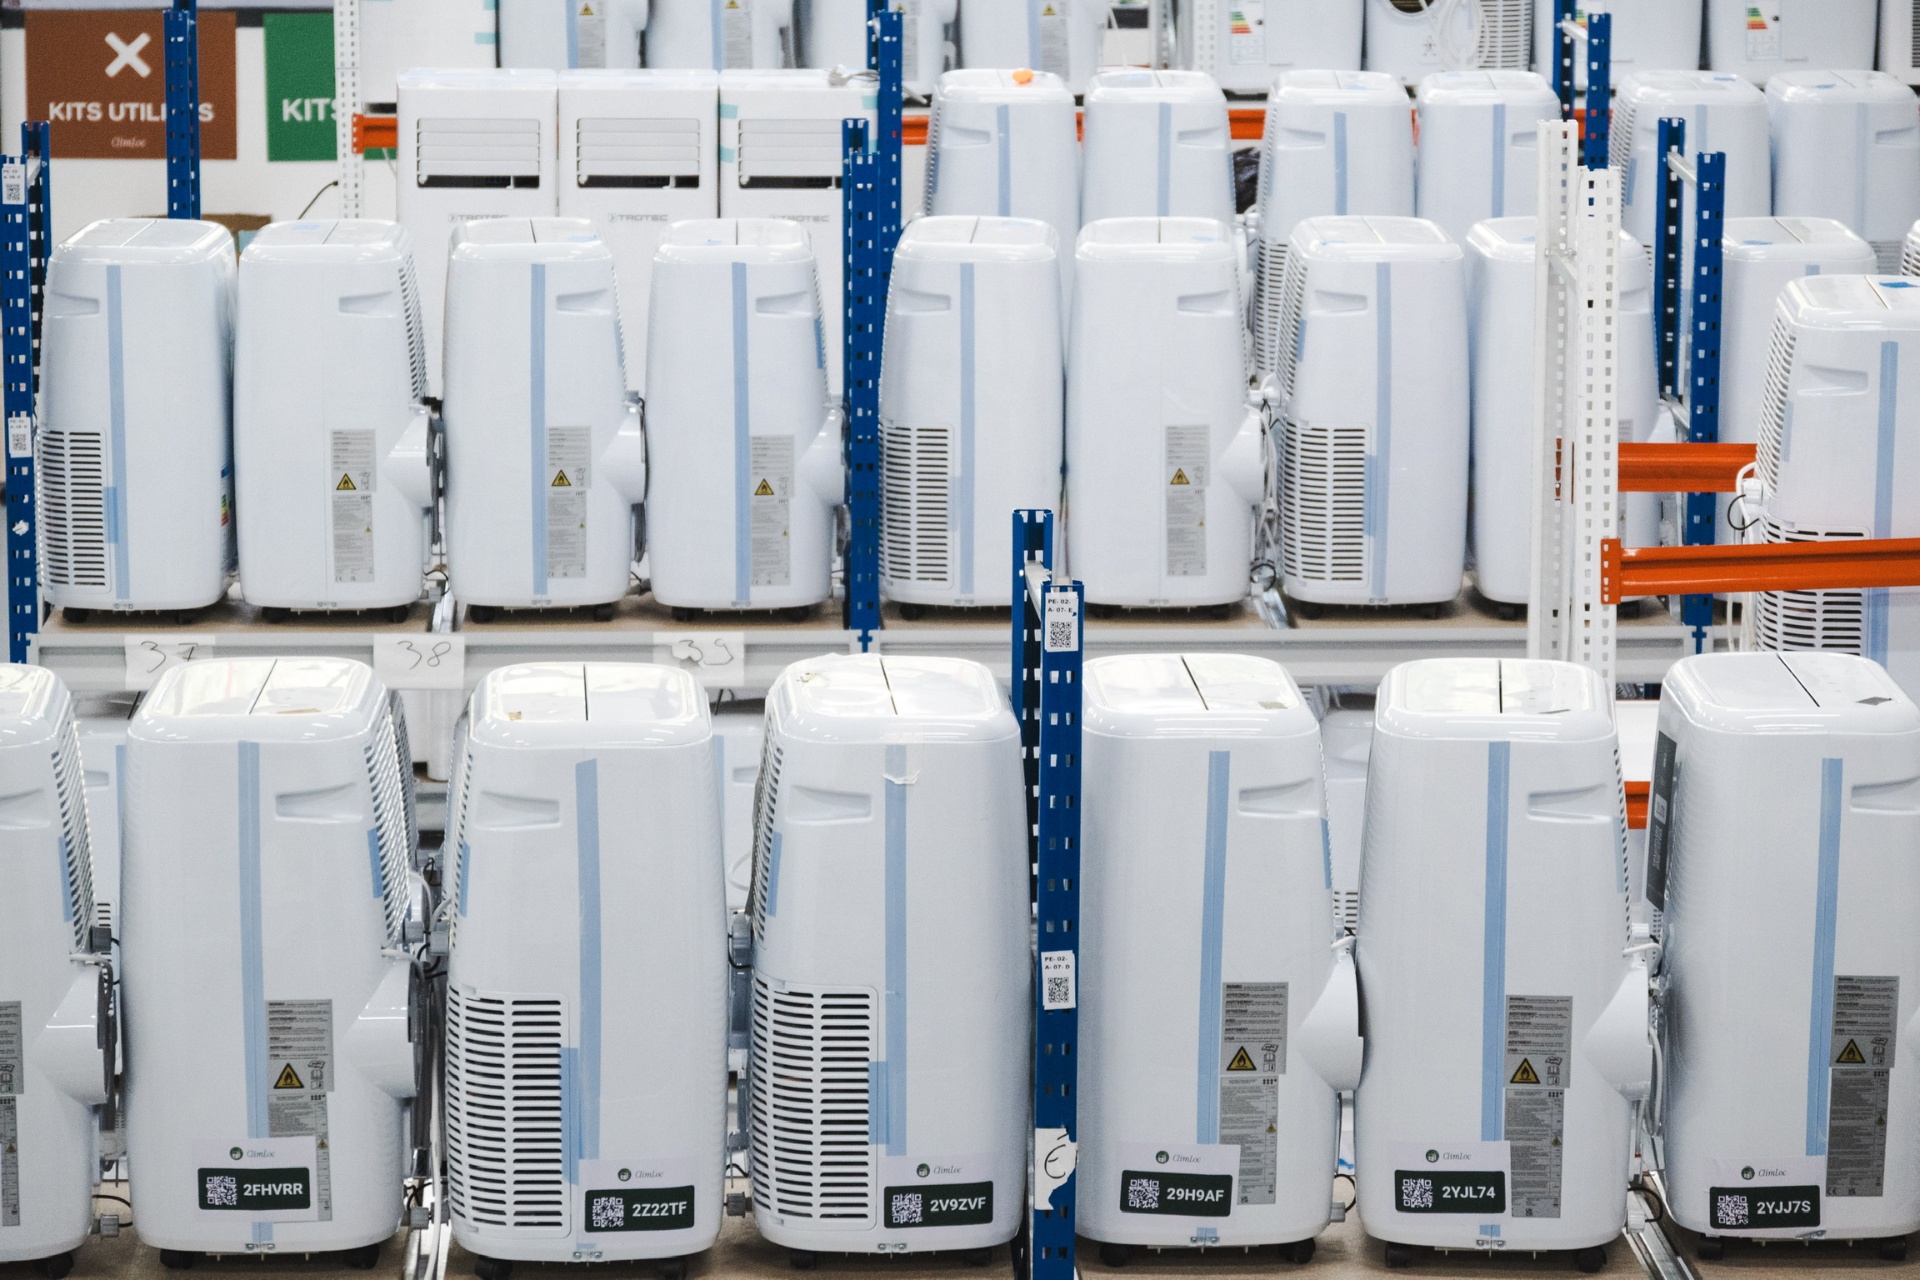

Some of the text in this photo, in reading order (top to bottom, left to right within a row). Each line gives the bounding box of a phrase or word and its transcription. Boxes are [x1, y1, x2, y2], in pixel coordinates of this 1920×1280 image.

[49, 102, 214, 121] KITS UTILIS
[397, 641, 451, 669] 38
[246, 1150, 275, 1158] ClimLoc
[1172, 1154, 1201, 1163] ClimLoc
[1442, 1152, 1471, 1160] ClimLoc
[635, 1170, 664, 1178] ClimLoc
[933, 1165, 962, 1174] ClimLoc
[1758, 1168, 1787, 1177] ClimLoc
[243, 1183, 304, 1196] 2FHVRR
[1166, 1187, 1225, 1202] 29H9AF
[1442, 1186, 1496, 1199] 2YJL74
[632, 1201, 687, 1217] 2Z22TF
[930, 1196, 986, 1212] 2V9ZVF
[1756, 1200, 1811, 1214] 2YJJ7S
